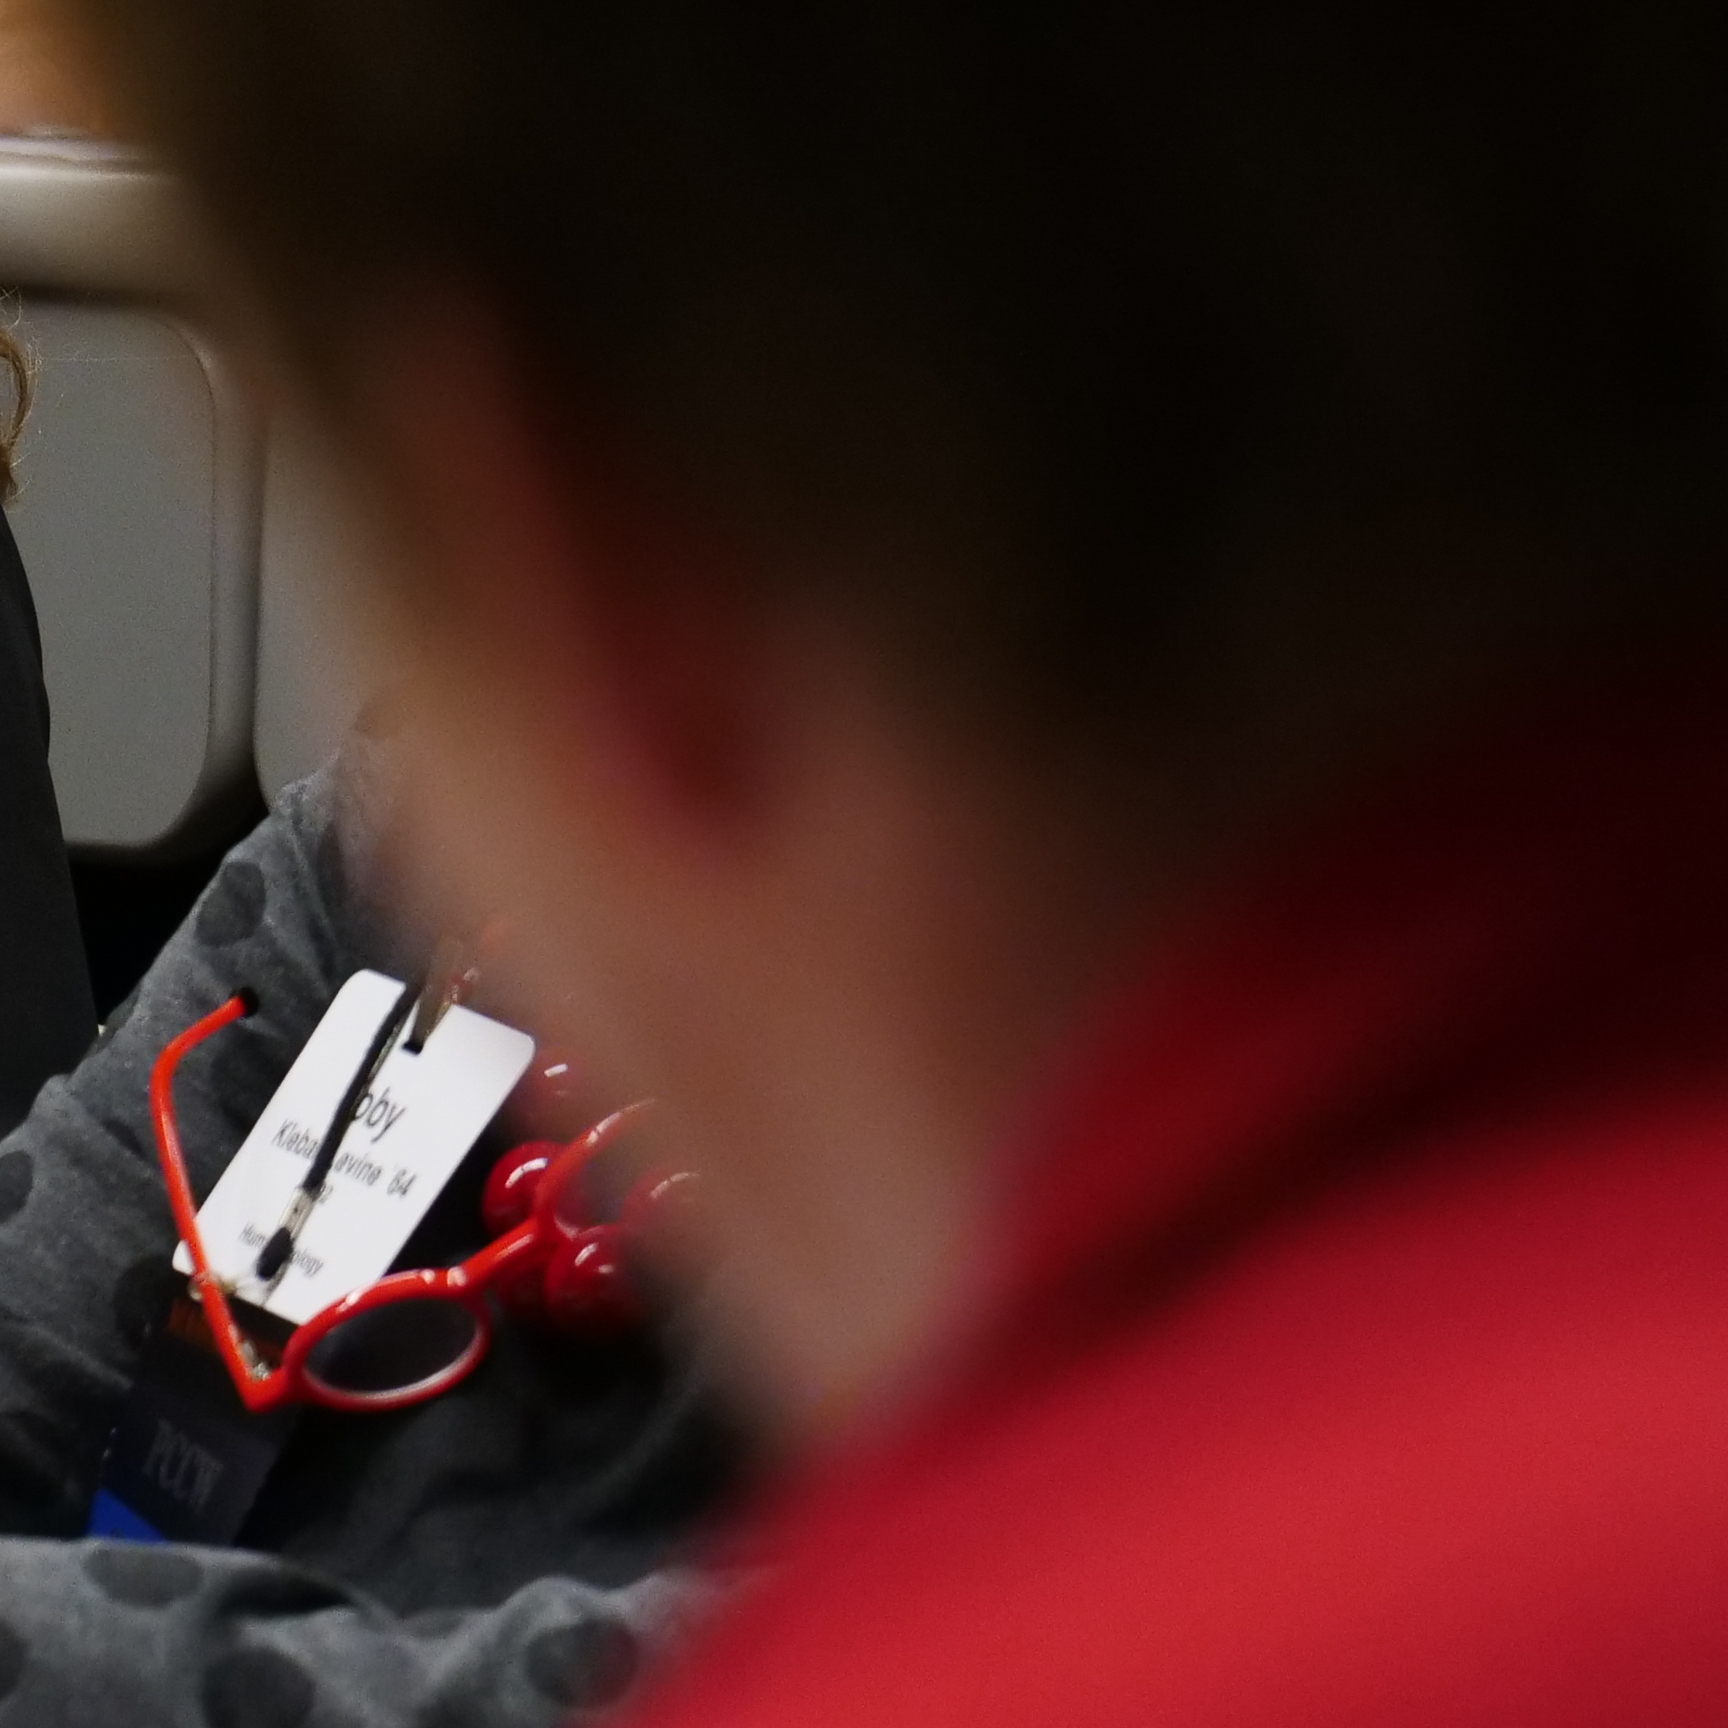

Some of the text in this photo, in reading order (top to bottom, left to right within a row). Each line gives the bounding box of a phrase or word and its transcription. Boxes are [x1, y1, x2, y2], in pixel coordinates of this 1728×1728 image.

[353, 1086, 406, 1144] oby
[271, 1119, 320, 1161] Kleba
[332, 1152, 382, 1186] evine
